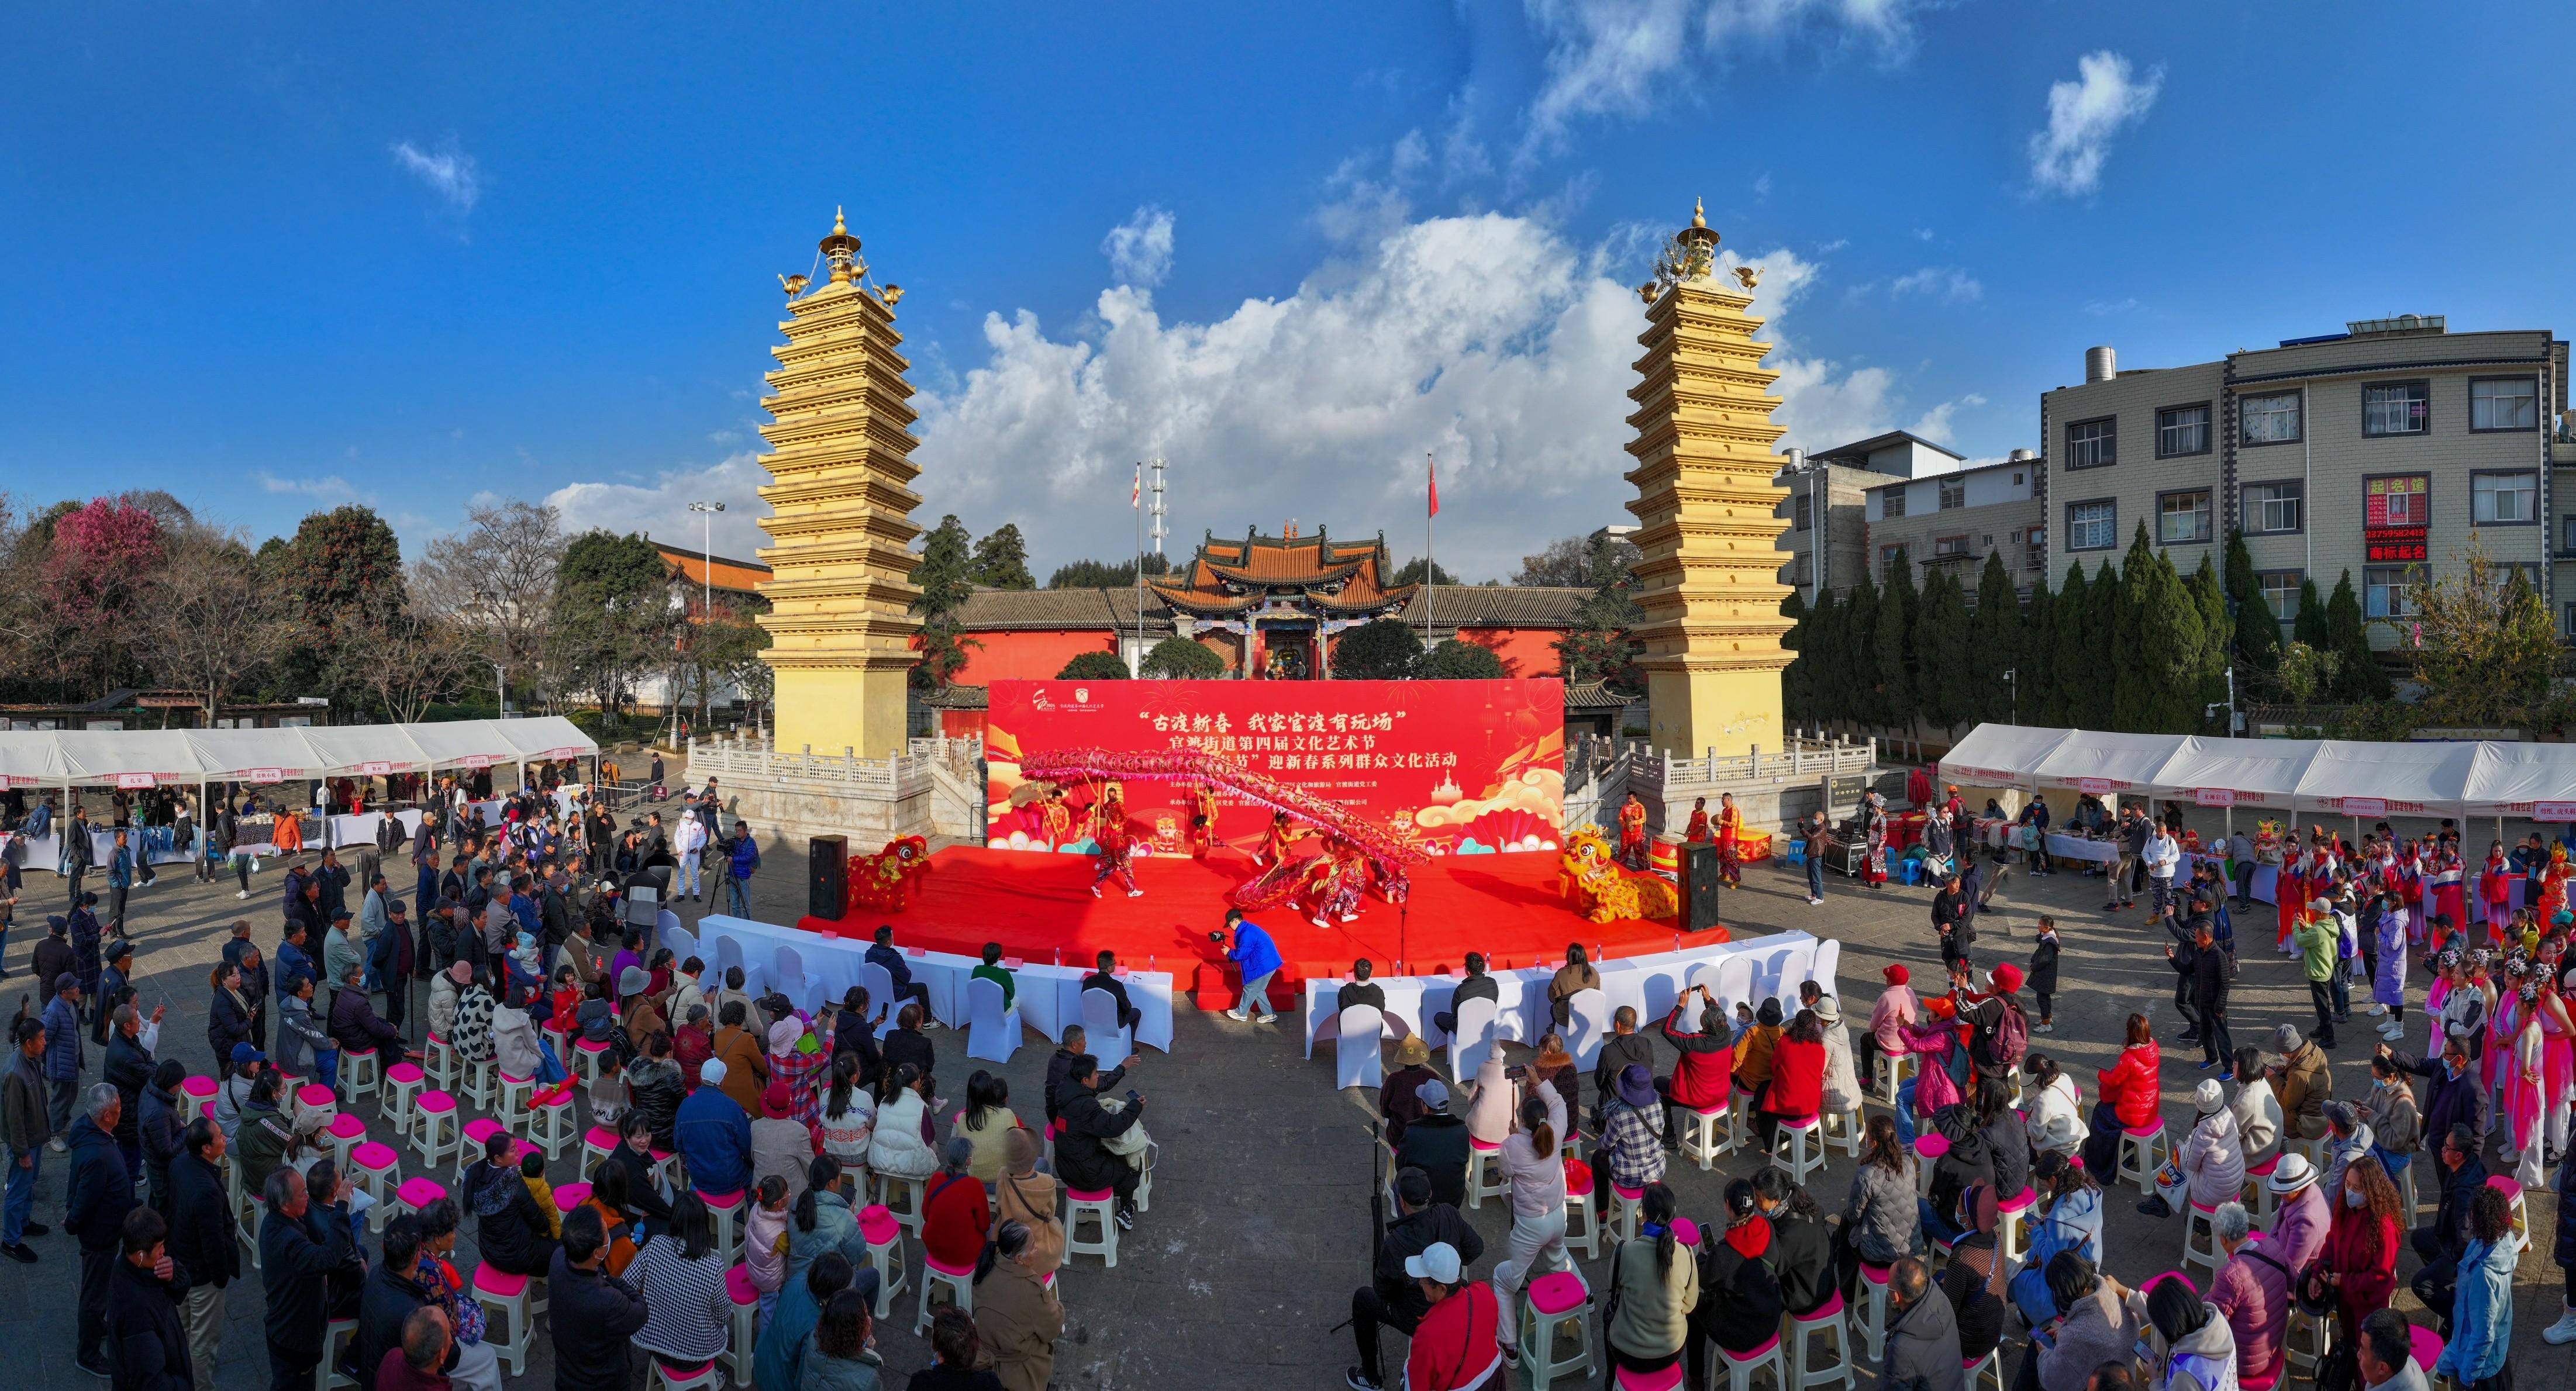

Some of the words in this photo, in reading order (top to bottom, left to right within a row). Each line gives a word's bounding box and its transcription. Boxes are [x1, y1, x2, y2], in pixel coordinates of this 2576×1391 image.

[2371, 478, 2424, 493] 起名馆
[2367, 529, 2424, 539] 13759582413
[2370, 545, 2426, 560] 商标起名
[1139, 711, 1232, 732] “古渡新春
[1247, 711, 1406, 732] 我家官渡有玩场”
[1169, 734, 1376, 751] 官渡街道第四届文化艺术节
[1268, 752, 1457, 769] 迎新春系列群众文化活动
[2510, 802, 2532, 812] 官渡社区
[263, 1119, 277, 1132] KEEP
